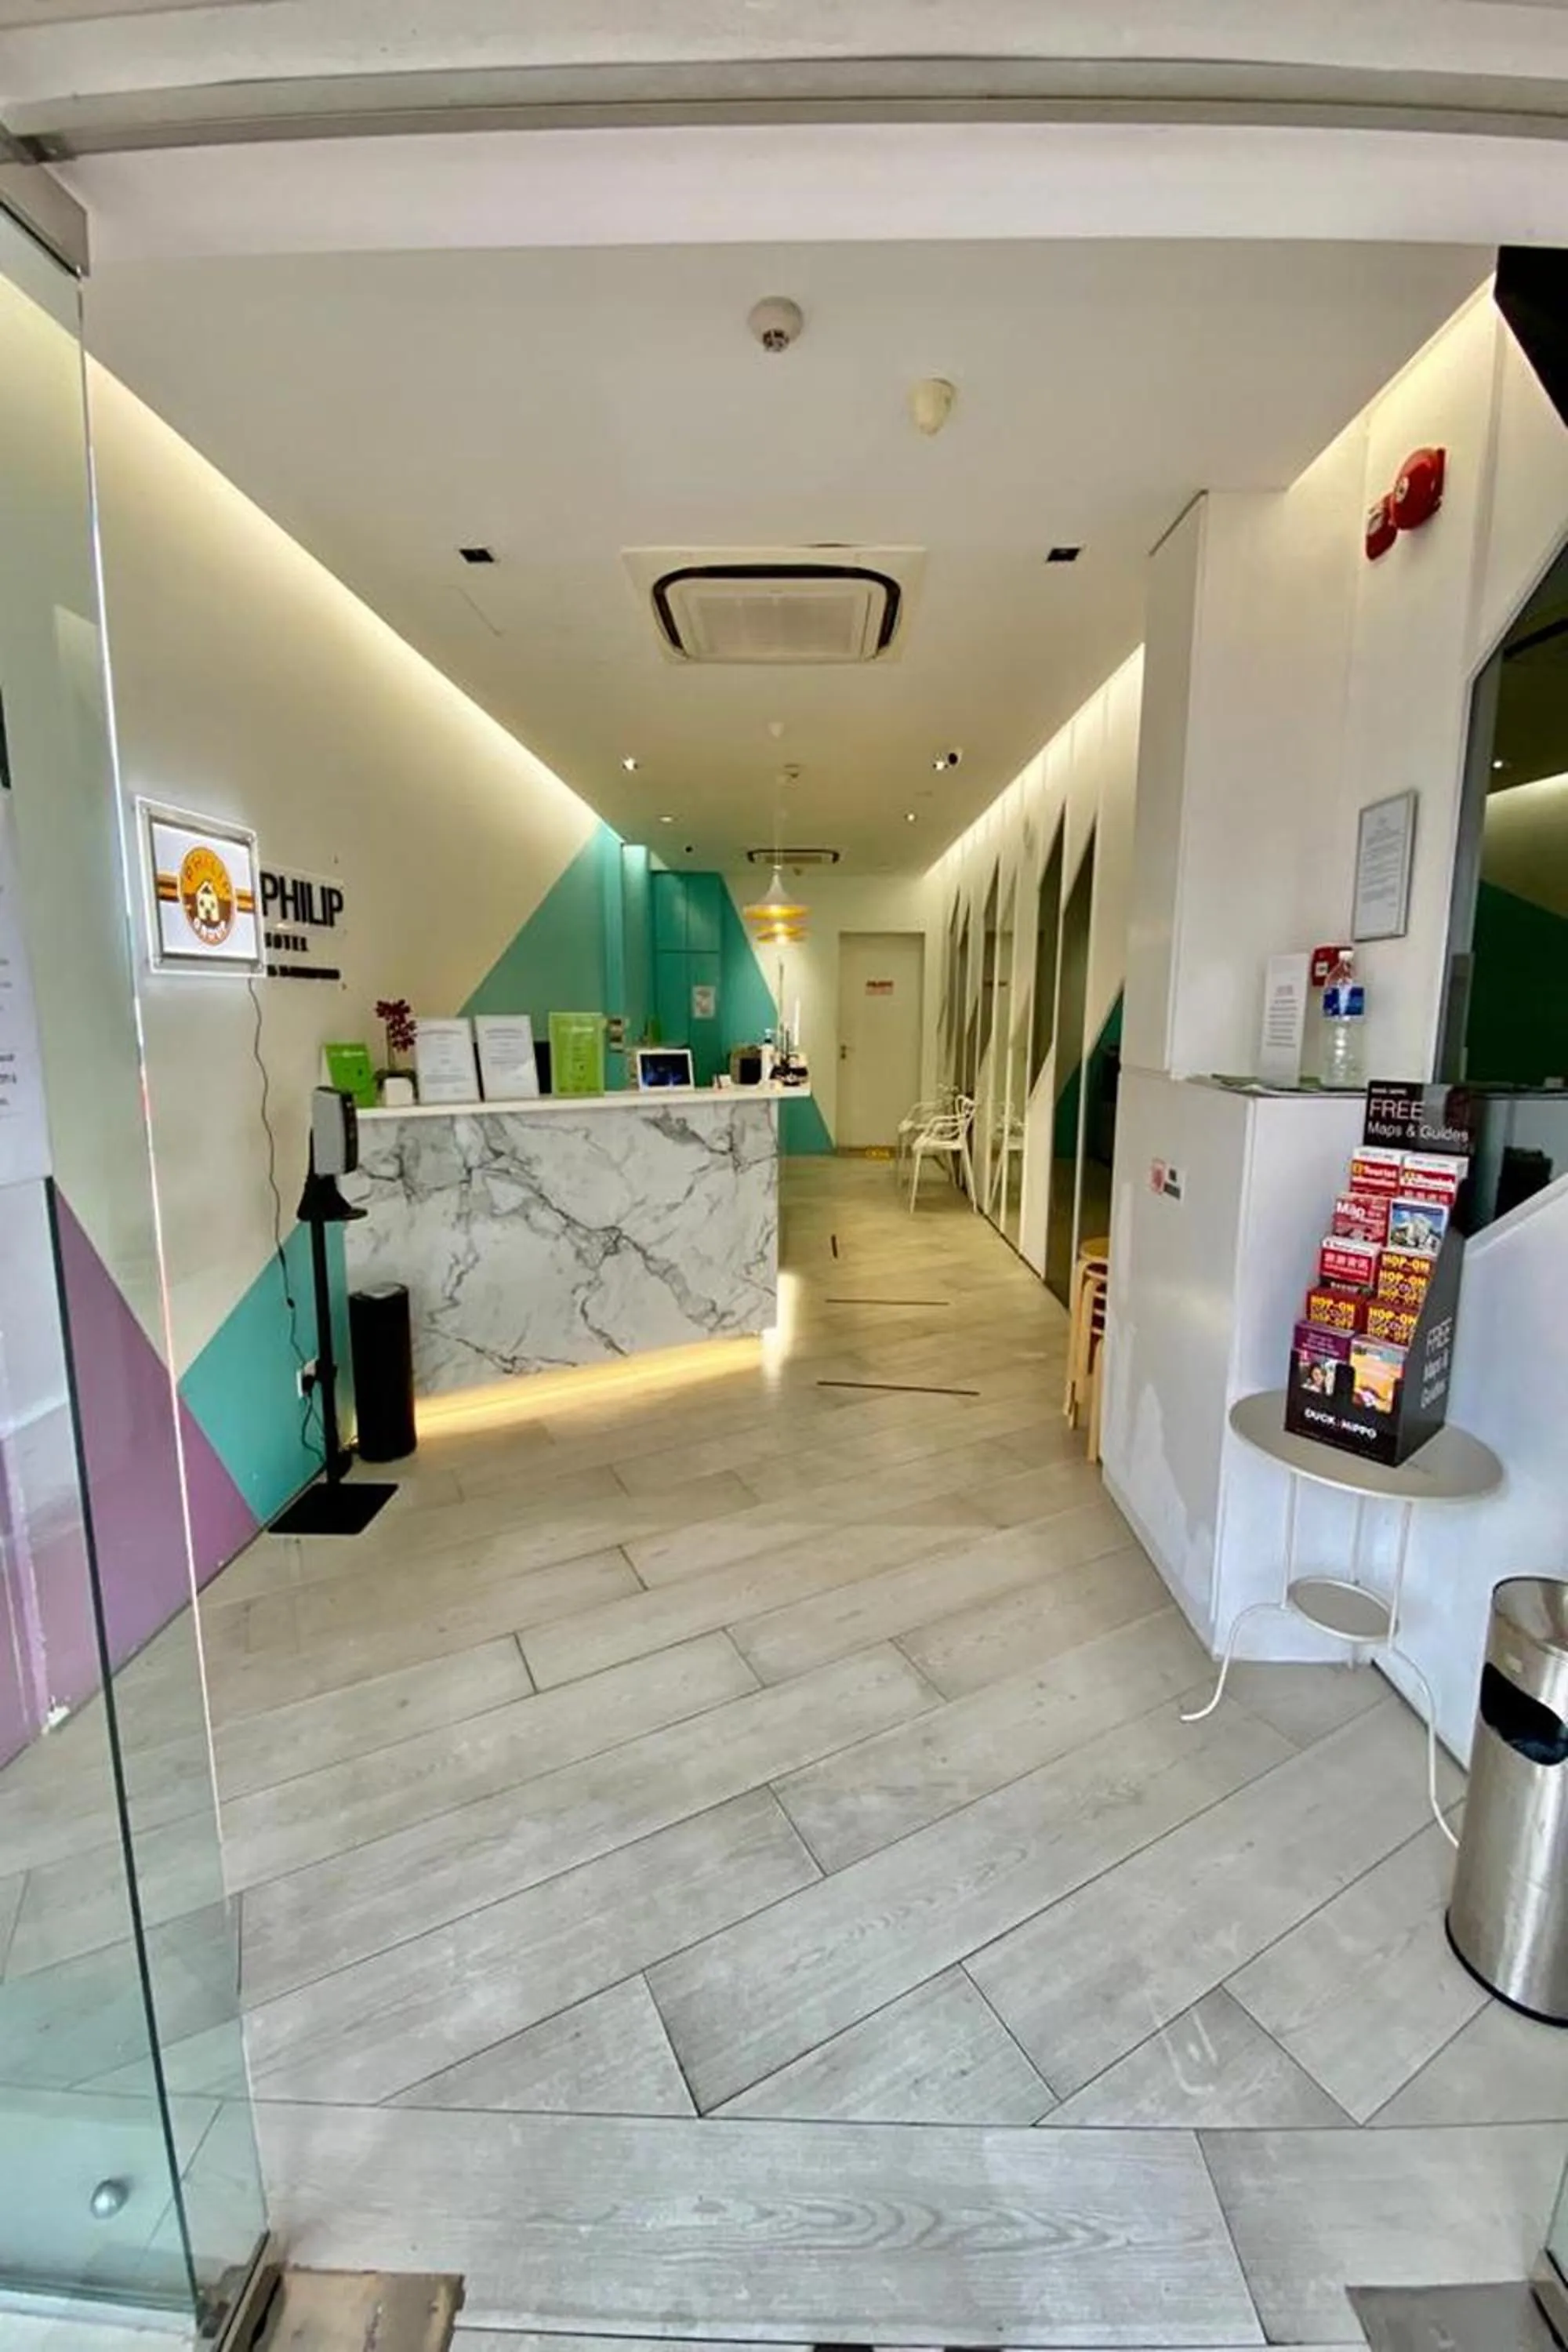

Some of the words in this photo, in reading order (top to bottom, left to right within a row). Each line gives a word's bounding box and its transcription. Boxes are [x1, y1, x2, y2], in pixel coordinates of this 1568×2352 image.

[260, 870, 343, 927] PHILIP
[1370, 1099, 1425, 1121] FREE
[1367, 1121, 1403, 1138] Maps
[1406, 1123, 1416, 1138] &
[1420, 1125, 1468, 1143] Guides
